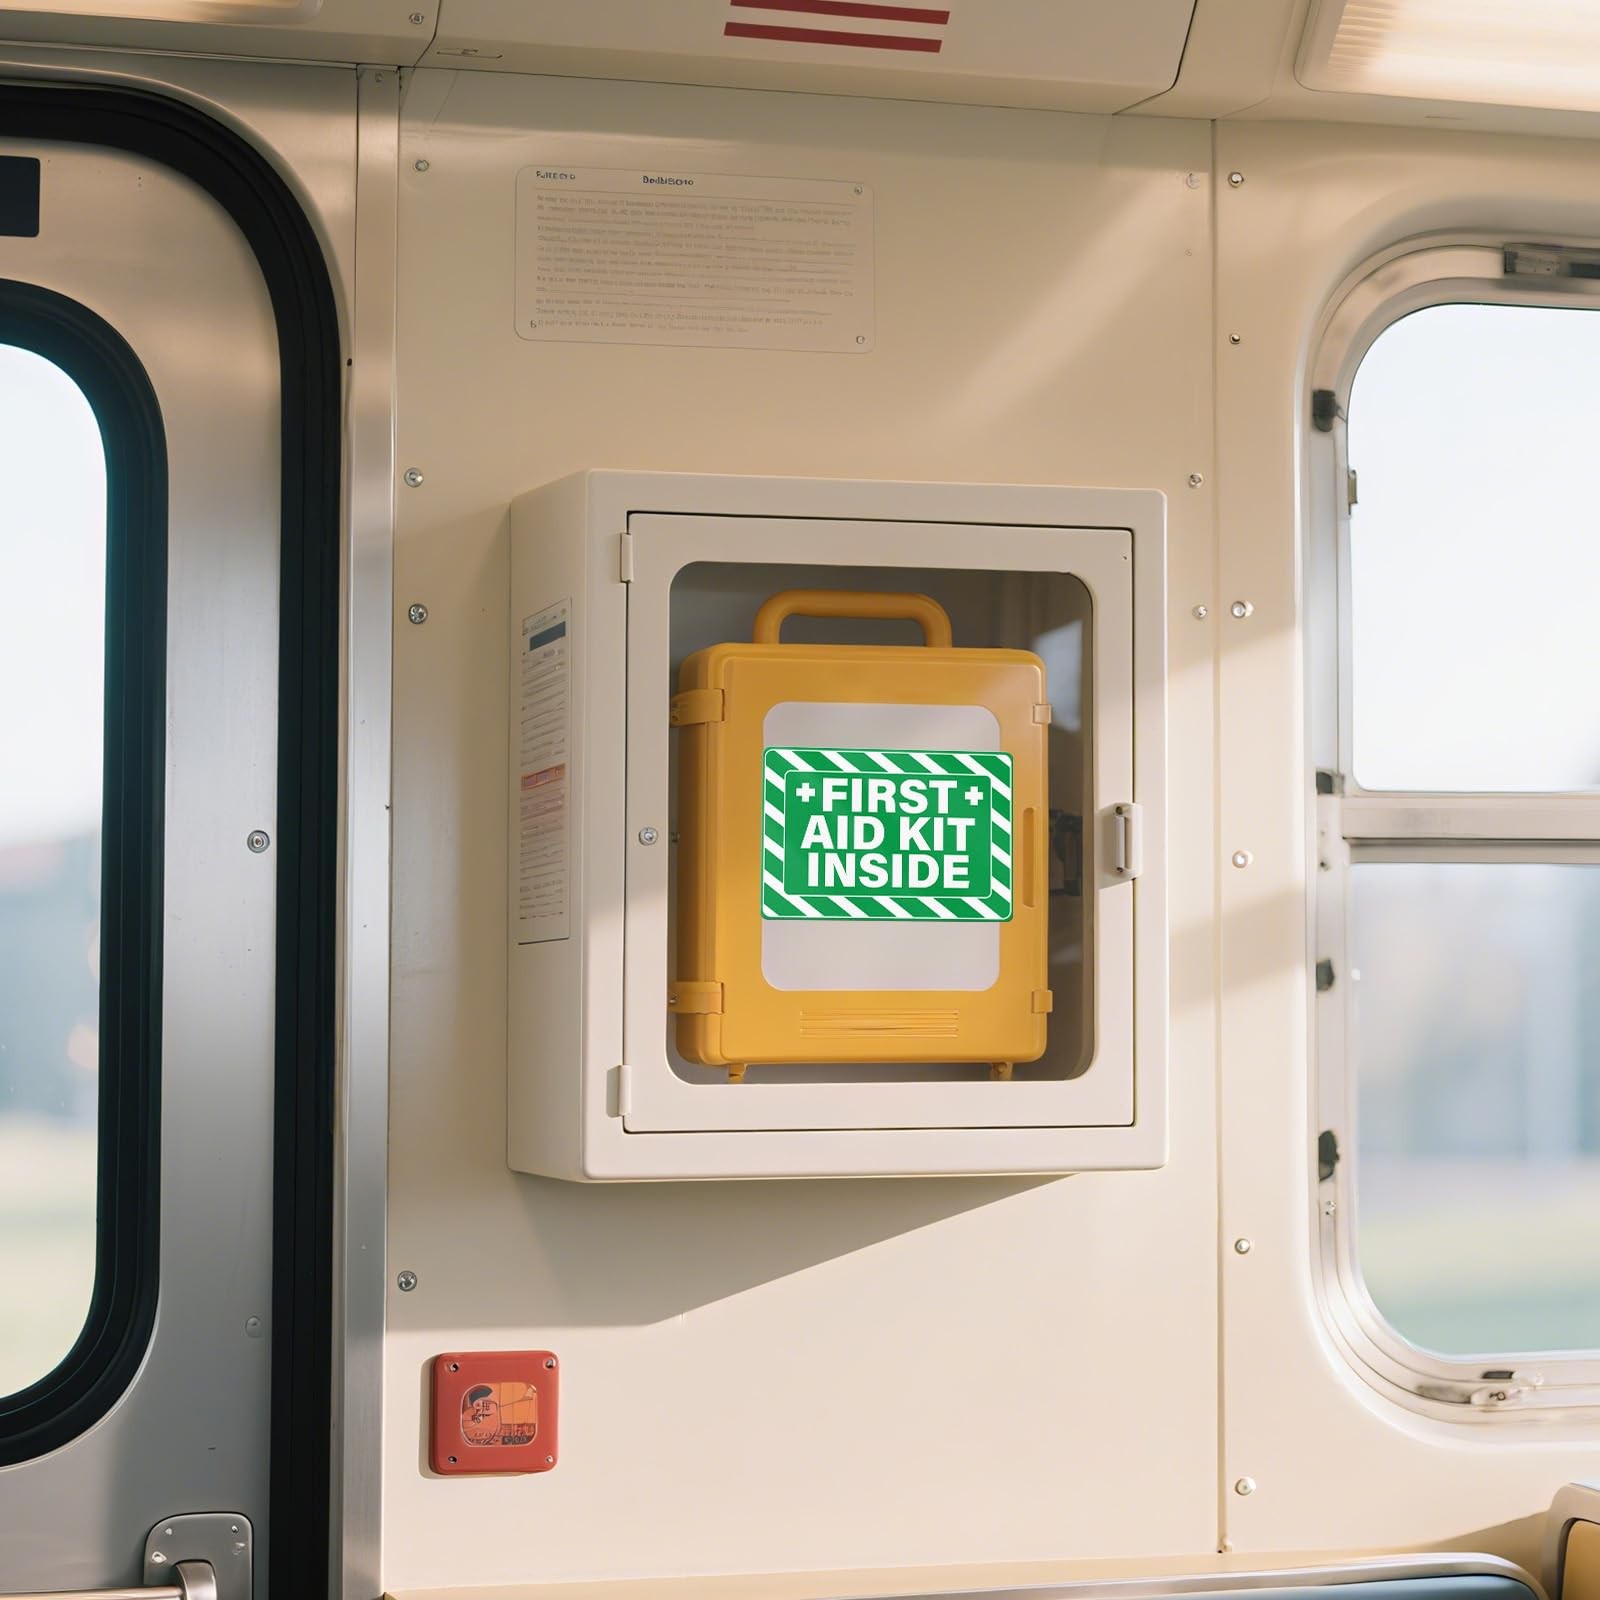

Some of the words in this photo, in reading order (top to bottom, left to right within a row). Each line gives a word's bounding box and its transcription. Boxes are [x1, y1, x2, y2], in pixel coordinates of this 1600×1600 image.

[822, 778, 957, 813] FIRST
[800, 815, 885, 850] AID
[899, 816, 976, 851] KIT
[807, 853, 970, 889] INSIDE
